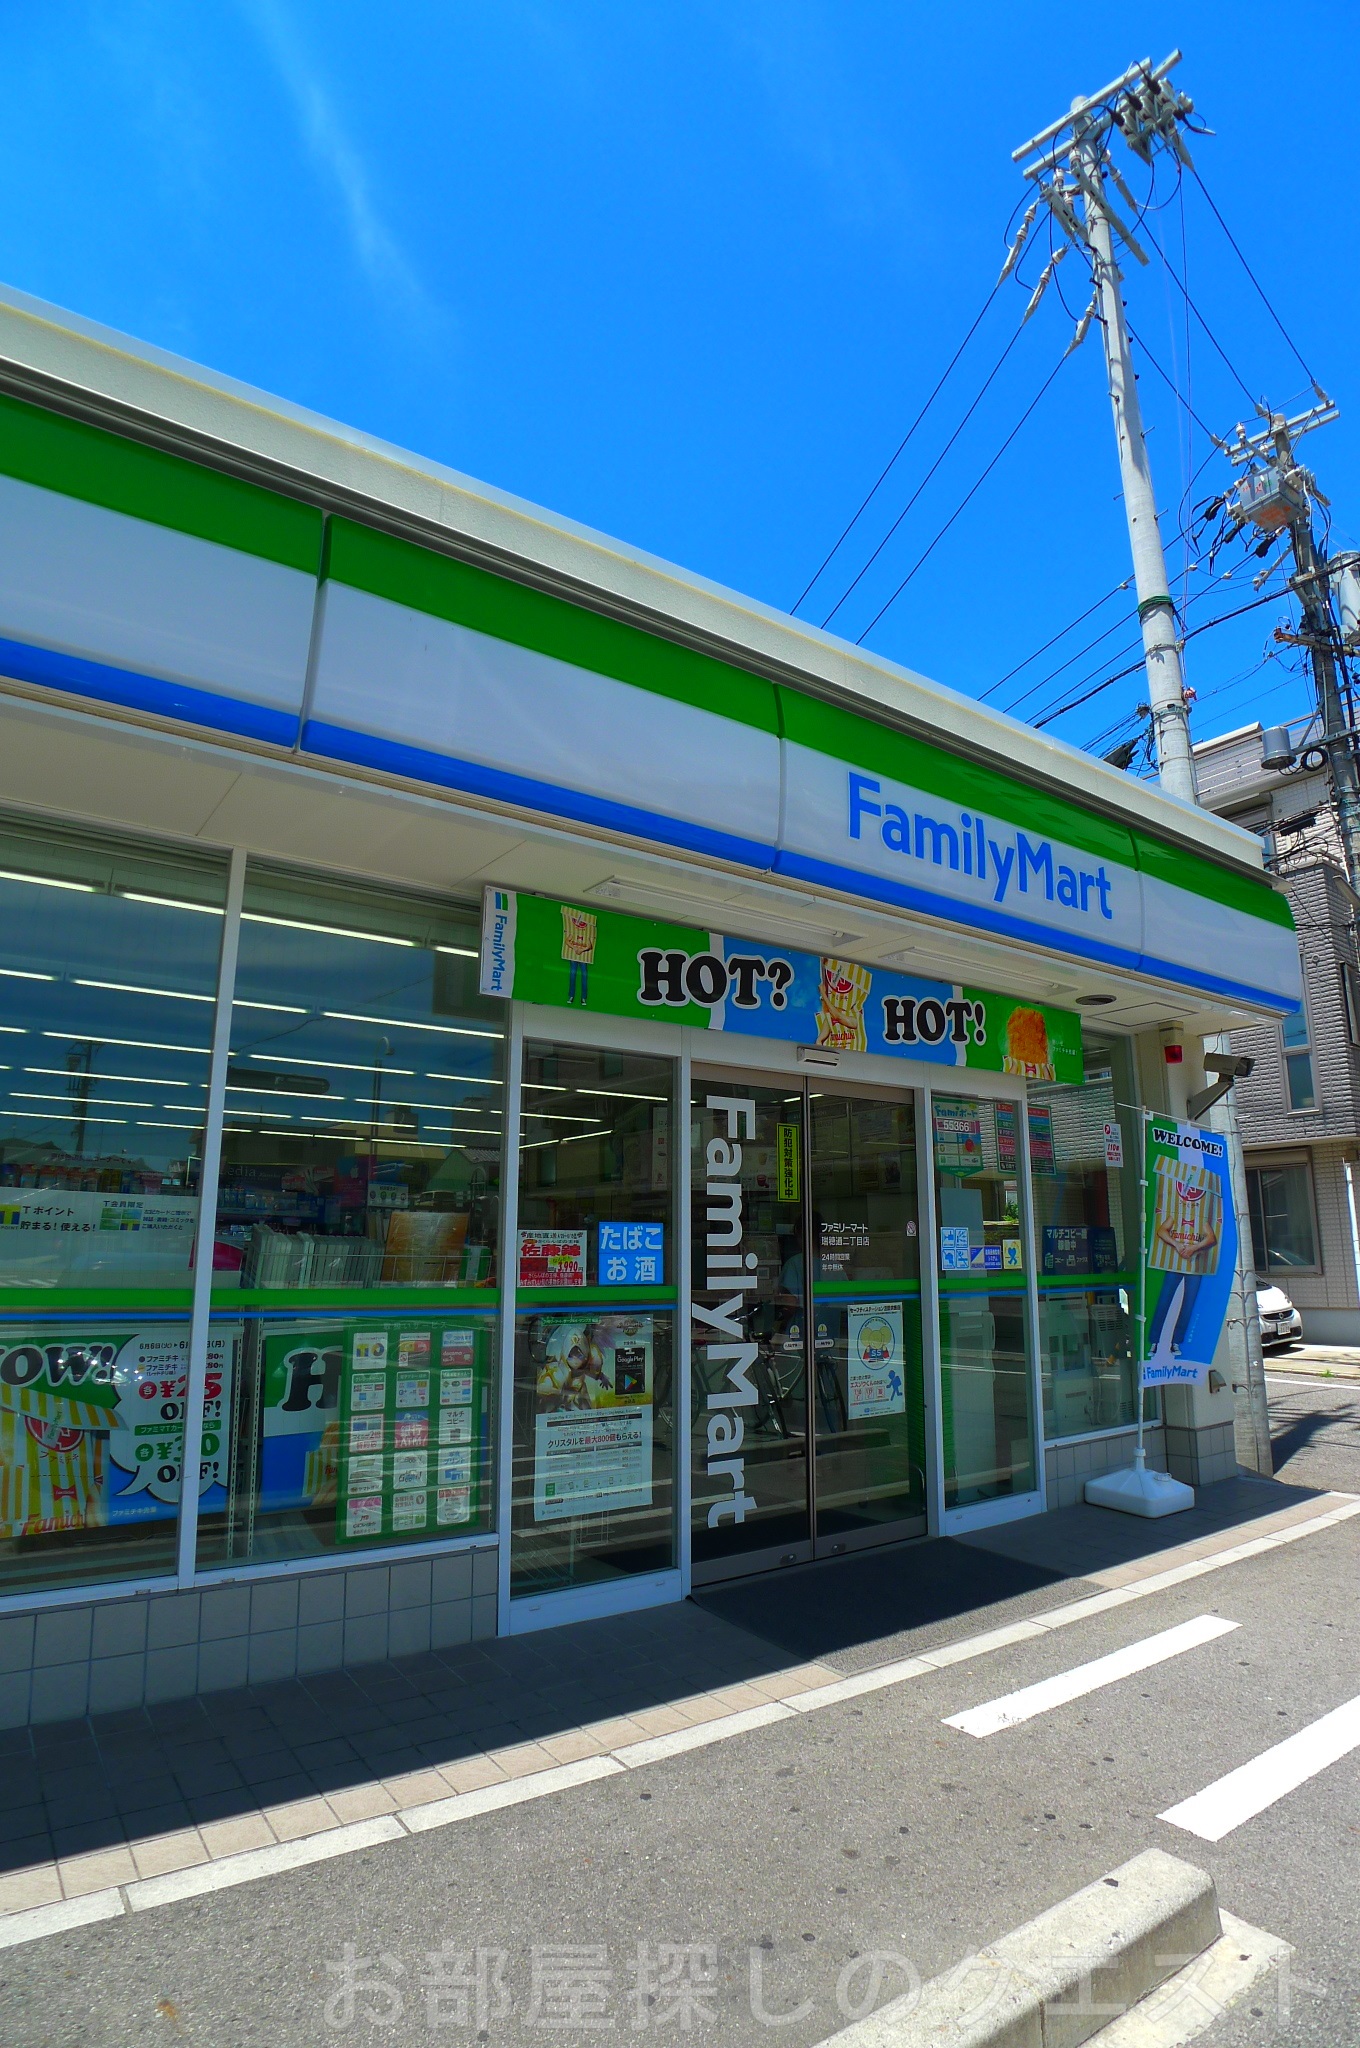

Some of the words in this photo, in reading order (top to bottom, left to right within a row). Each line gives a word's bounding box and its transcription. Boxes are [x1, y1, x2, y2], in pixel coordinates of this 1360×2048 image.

[849, 771, 1112, 920] FamilyMart
[490, 914, 508, 992] FamilyMart
[640, 951, 792, 1007] HOT?
[883, 998, 985, 1042] HOT!
[1153, 1128, 1223, 1156] WELCOME!
[784, 1127, 794, 1199] 防犯対策強化中
[23, 1205, 74, 1217] Tポイント
[104, 1200, 144, 1209] T会員限定
[601, 1225, 662, 1251] たばこ
[821, 1222, 869, 1234] ファミリーマート
[606, 1256, 656, 1282] お酒
[691, 1094, 759, 1529] FamilyMart
[146, 1354, 179, 1362] ファミチキ
[146, 1363, 178, 1371] ファミチキ
[1146, 1365, 1198, 1379] FamilyMart
